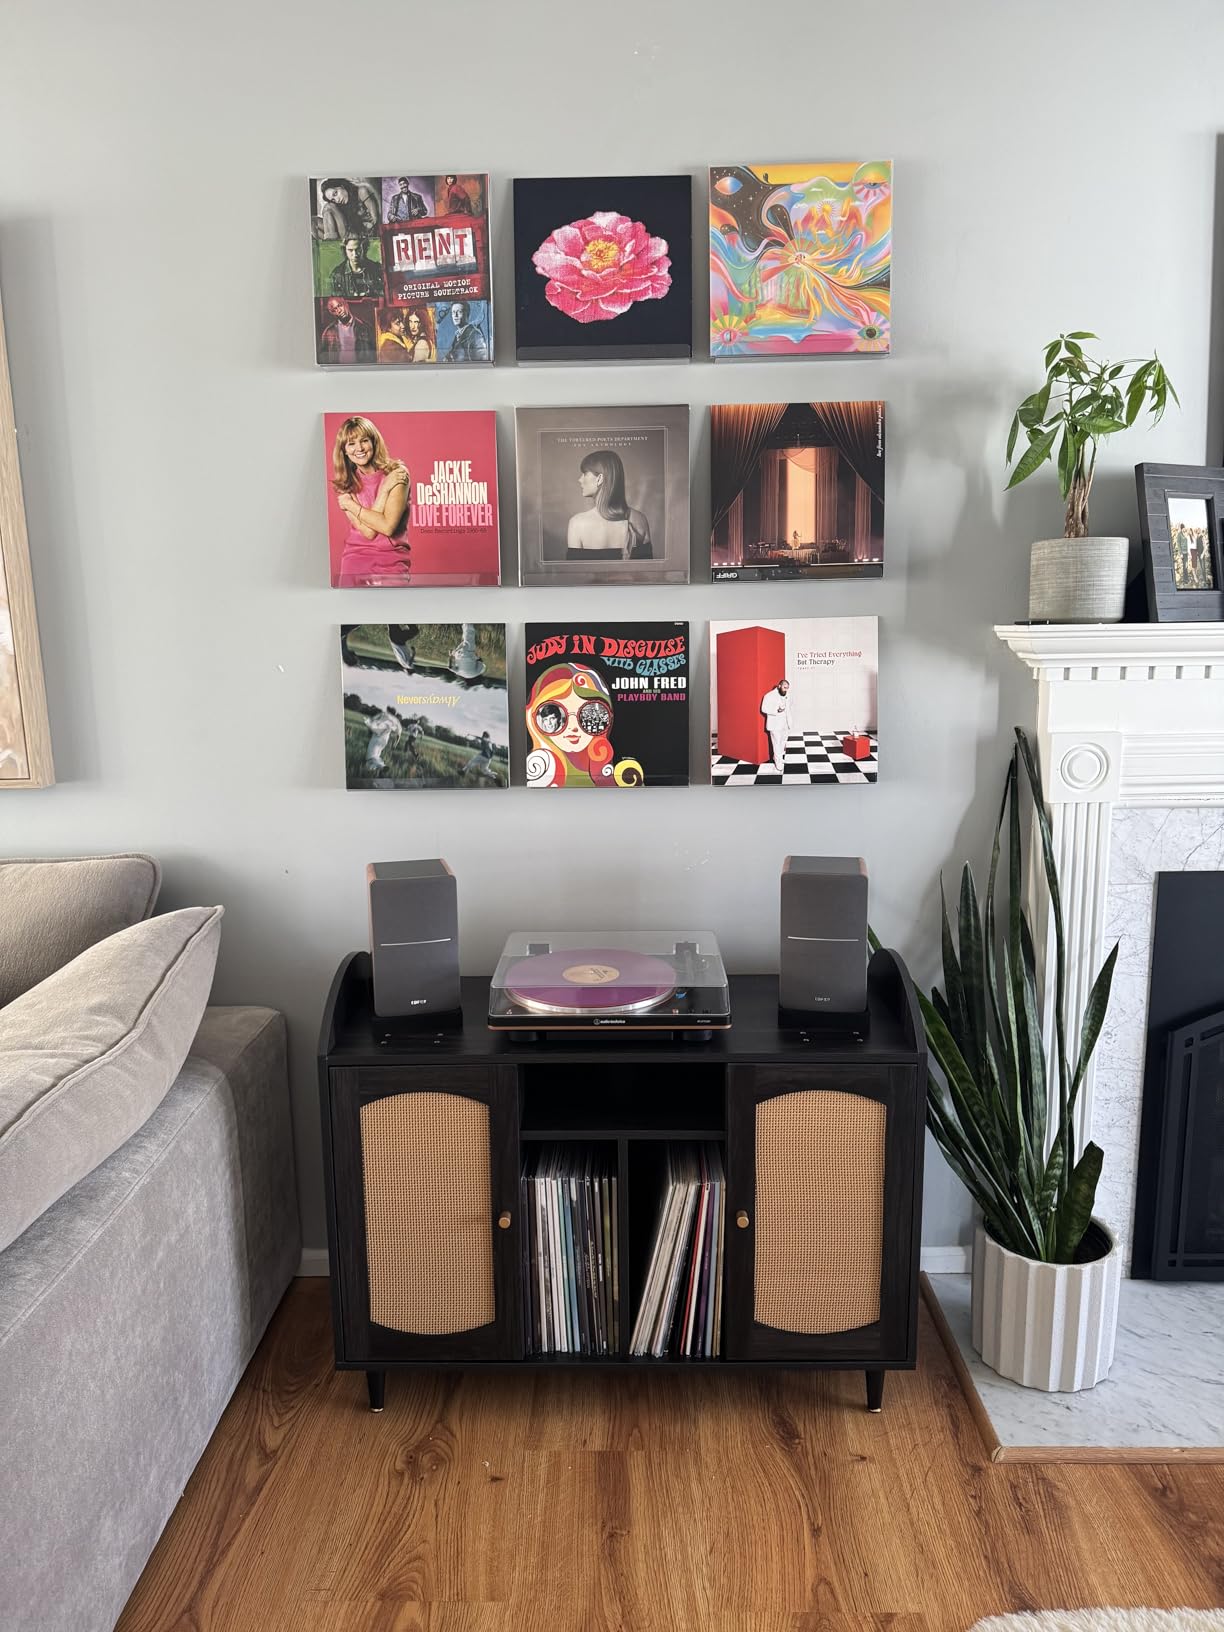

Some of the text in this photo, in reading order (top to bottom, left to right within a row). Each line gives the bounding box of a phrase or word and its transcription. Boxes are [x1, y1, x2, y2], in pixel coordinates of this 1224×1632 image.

[395, 231, 468, 262] RENT
[398, 286, 479, 300] PICTURE SOUNDTRACK
[403, 279, 471, 291] ORIGINAL MOTION
[430, 460, 473, 483] JACKIE
[416, 481, 488, 505] DeSHANNON
[411, 503, 494, 527] LOVE FOREVER
[526, 635, 570, 665] JUDY
[599, 635, 686, 658] DISGUISE
[828, 650, 863, 658] Everything
[635, 653, 687, 676] GLASSES
[809, 658, 836, 666] Therapy
[612, 676, 687, 690] JOHN FRED
[617, 692, 686, 702] PLAYBOY BAND
